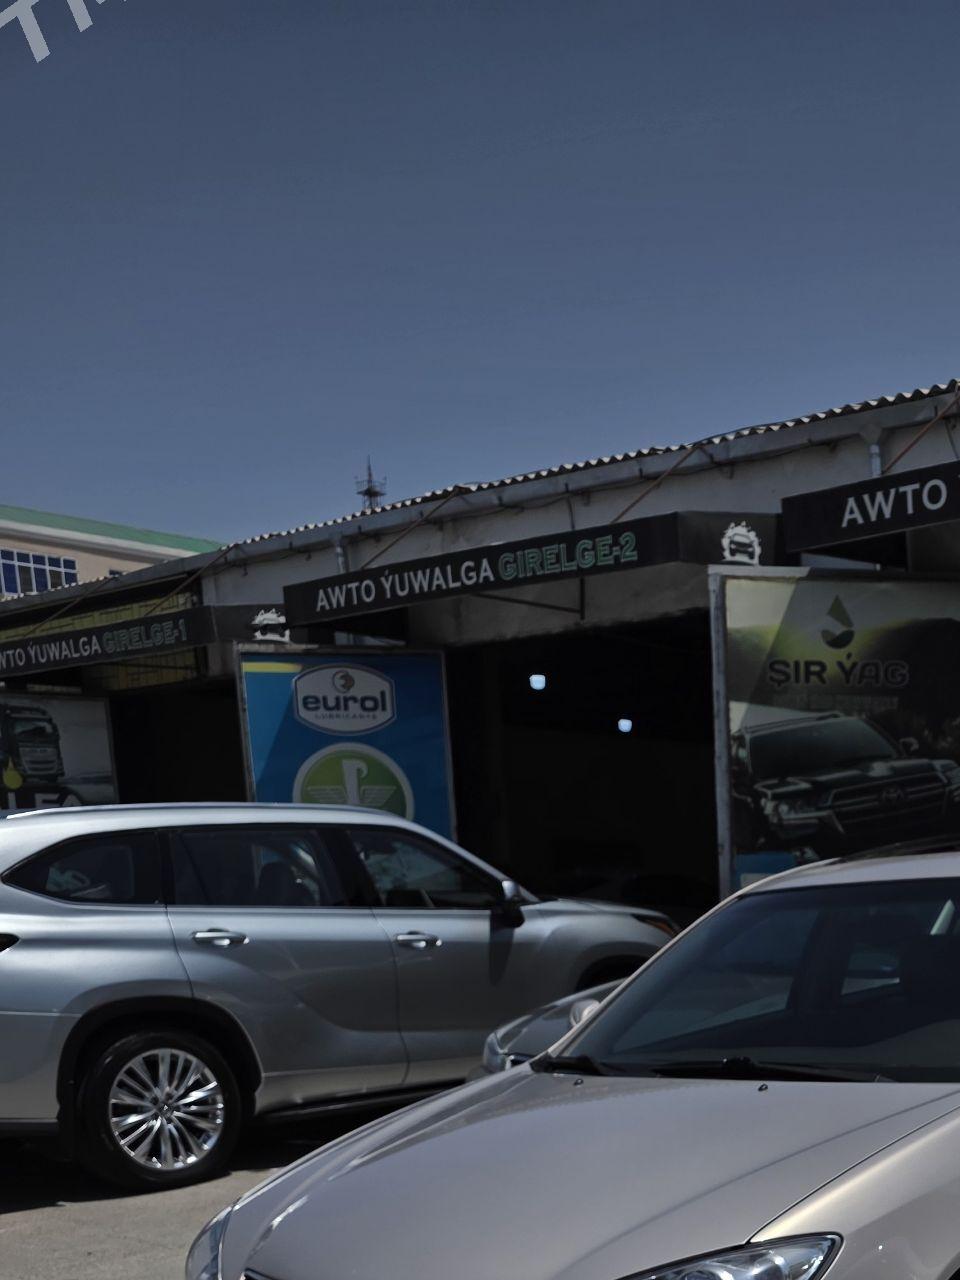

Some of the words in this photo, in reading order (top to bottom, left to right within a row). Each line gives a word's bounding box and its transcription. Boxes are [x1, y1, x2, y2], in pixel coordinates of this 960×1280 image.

[841, 478, 948, 528] AWTO
[315, 580, 376, 612] AWTO
[380, 558, 495, 599] ÝUWALGA
[499, 531, 639, 581] GIRELGE-2
[27, 635, 102, 665] ÝUWALGA
[101, 619, 188, 653] GIRELGE-1
[768, 659, 827, 688] ŞIR
[837, 653, 911, 688] ÝAG
[301, 689, 387, 712] eurol
